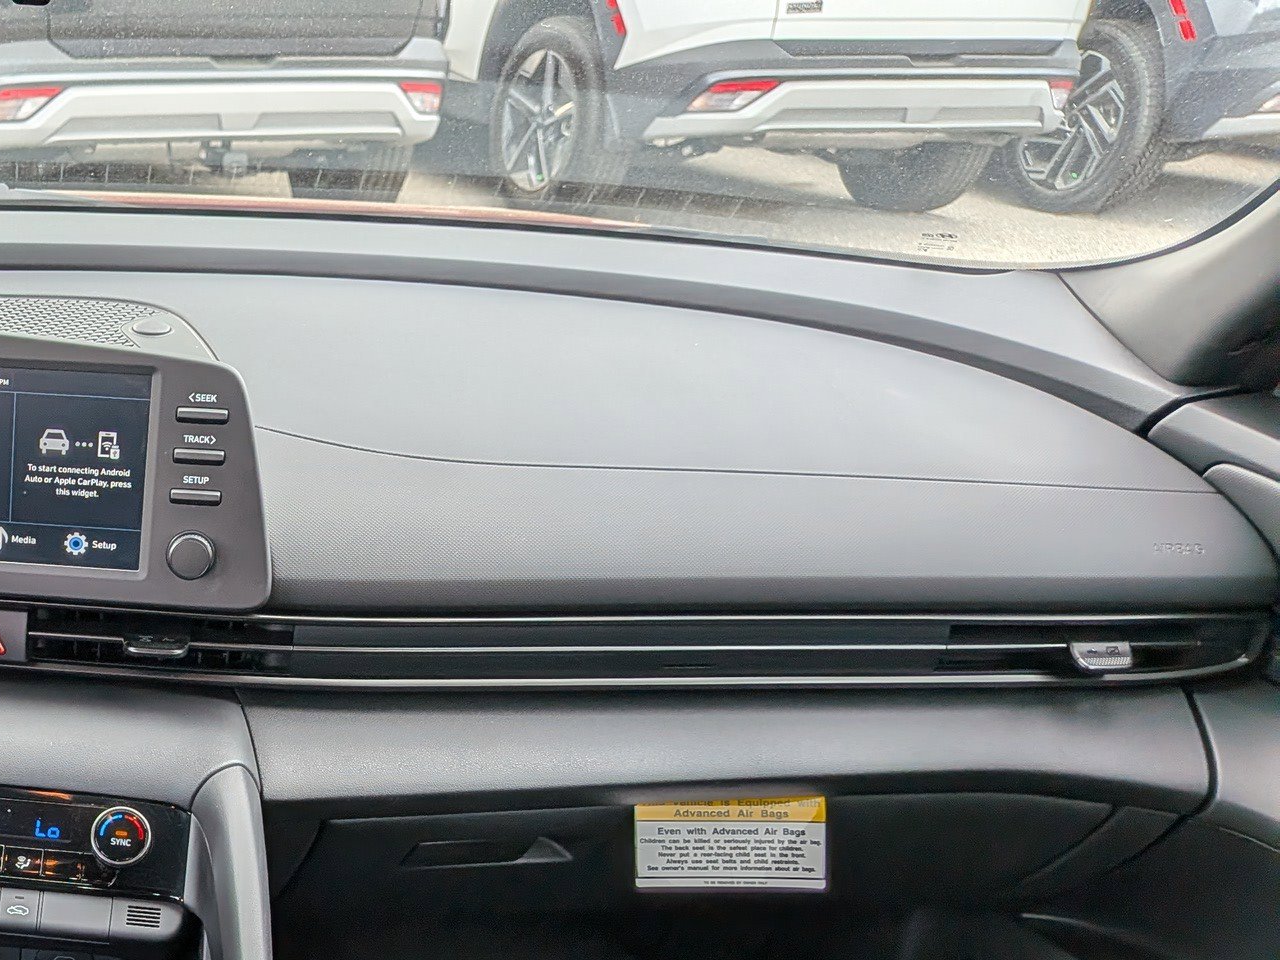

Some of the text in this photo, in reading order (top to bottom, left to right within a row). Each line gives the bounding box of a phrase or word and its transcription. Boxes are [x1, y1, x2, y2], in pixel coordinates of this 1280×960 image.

[27, 463, 131, 477] To start connecting Android
[24, 475, 42, 483] Auto
[54, 476, 76, 486] Apple
[77, 478, 109, 488] CarPlay,
[110, 481, 132, 489] press
[183, 476, 209, 484] SETUP
[55, 488, 99, 498] this widget.
[11, 535, 37, 545] Media
[92, 540, 117, 551] Setup
[674, 809, 789, 819] Advanced Air Bags
[783, 828, 806, 837] Bags
[110, 837, 131, 847] SYNC
